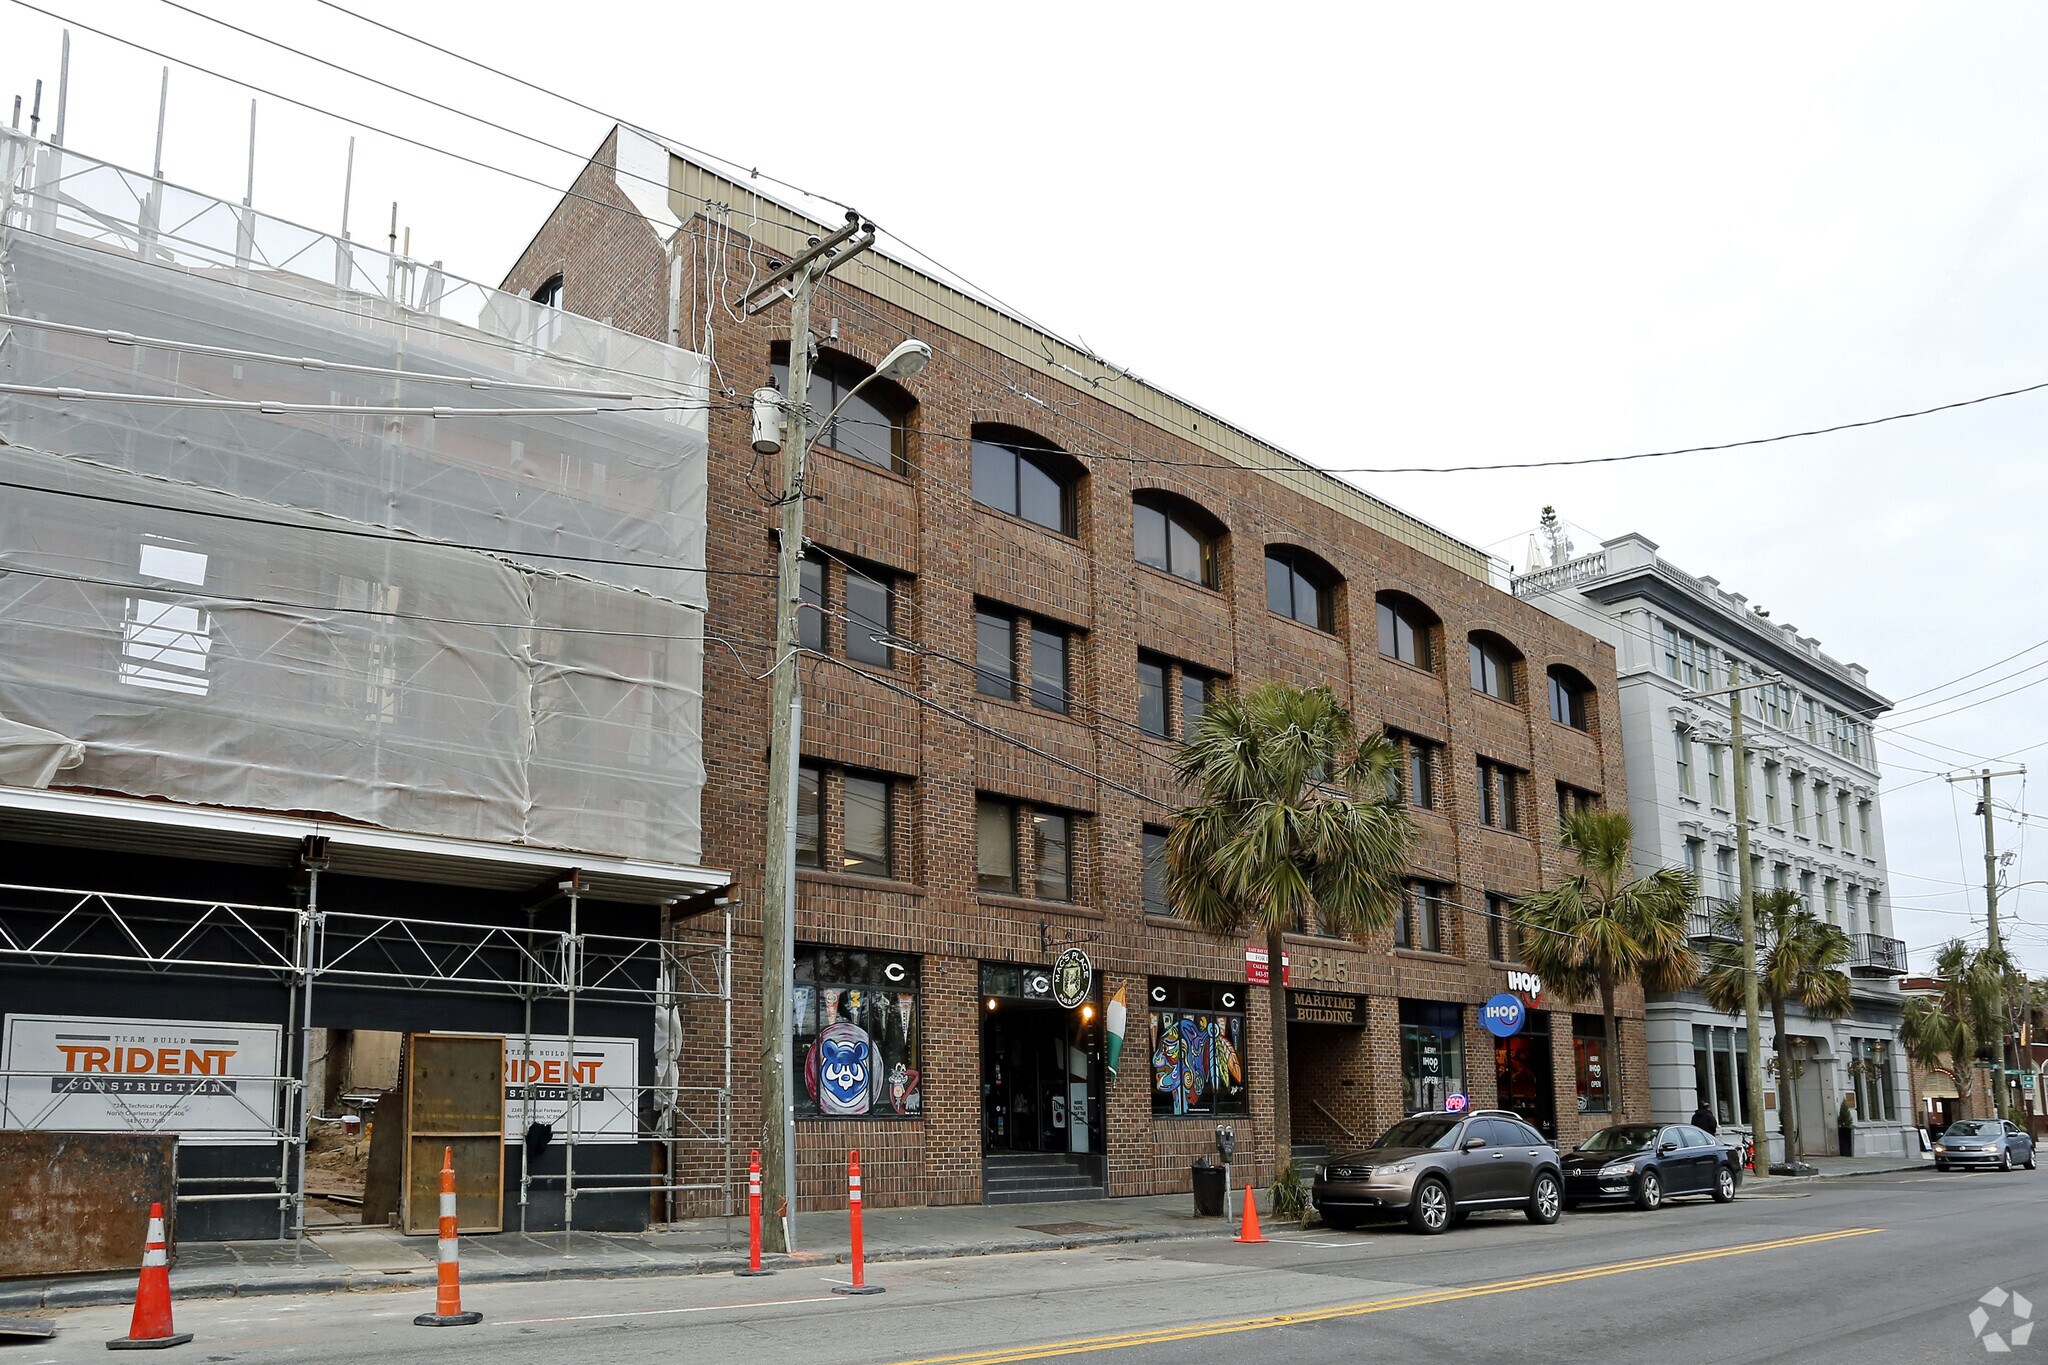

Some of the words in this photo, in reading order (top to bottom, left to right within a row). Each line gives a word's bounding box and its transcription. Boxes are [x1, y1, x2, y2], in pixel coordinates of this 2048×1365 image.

[1072, 952, 1089, 978] PLACE
[1309, 957, 1348, 983] 215
[1294, 993, 1356, 1010] MARITIME
[1297, 1008, 1353, 1023] BUILDING
[114, 1035, 145, 1043] TEAM
[153, 1036, 187, 1044] BUILD
[55, 1045, 238, 1075] TRIDENT
[69, 1080, 221, 1094] CONSTRUCTION
[1424, 1076, 1438, 1084] OPEN
[1447, 1097, 1463, 1109] OPEN
